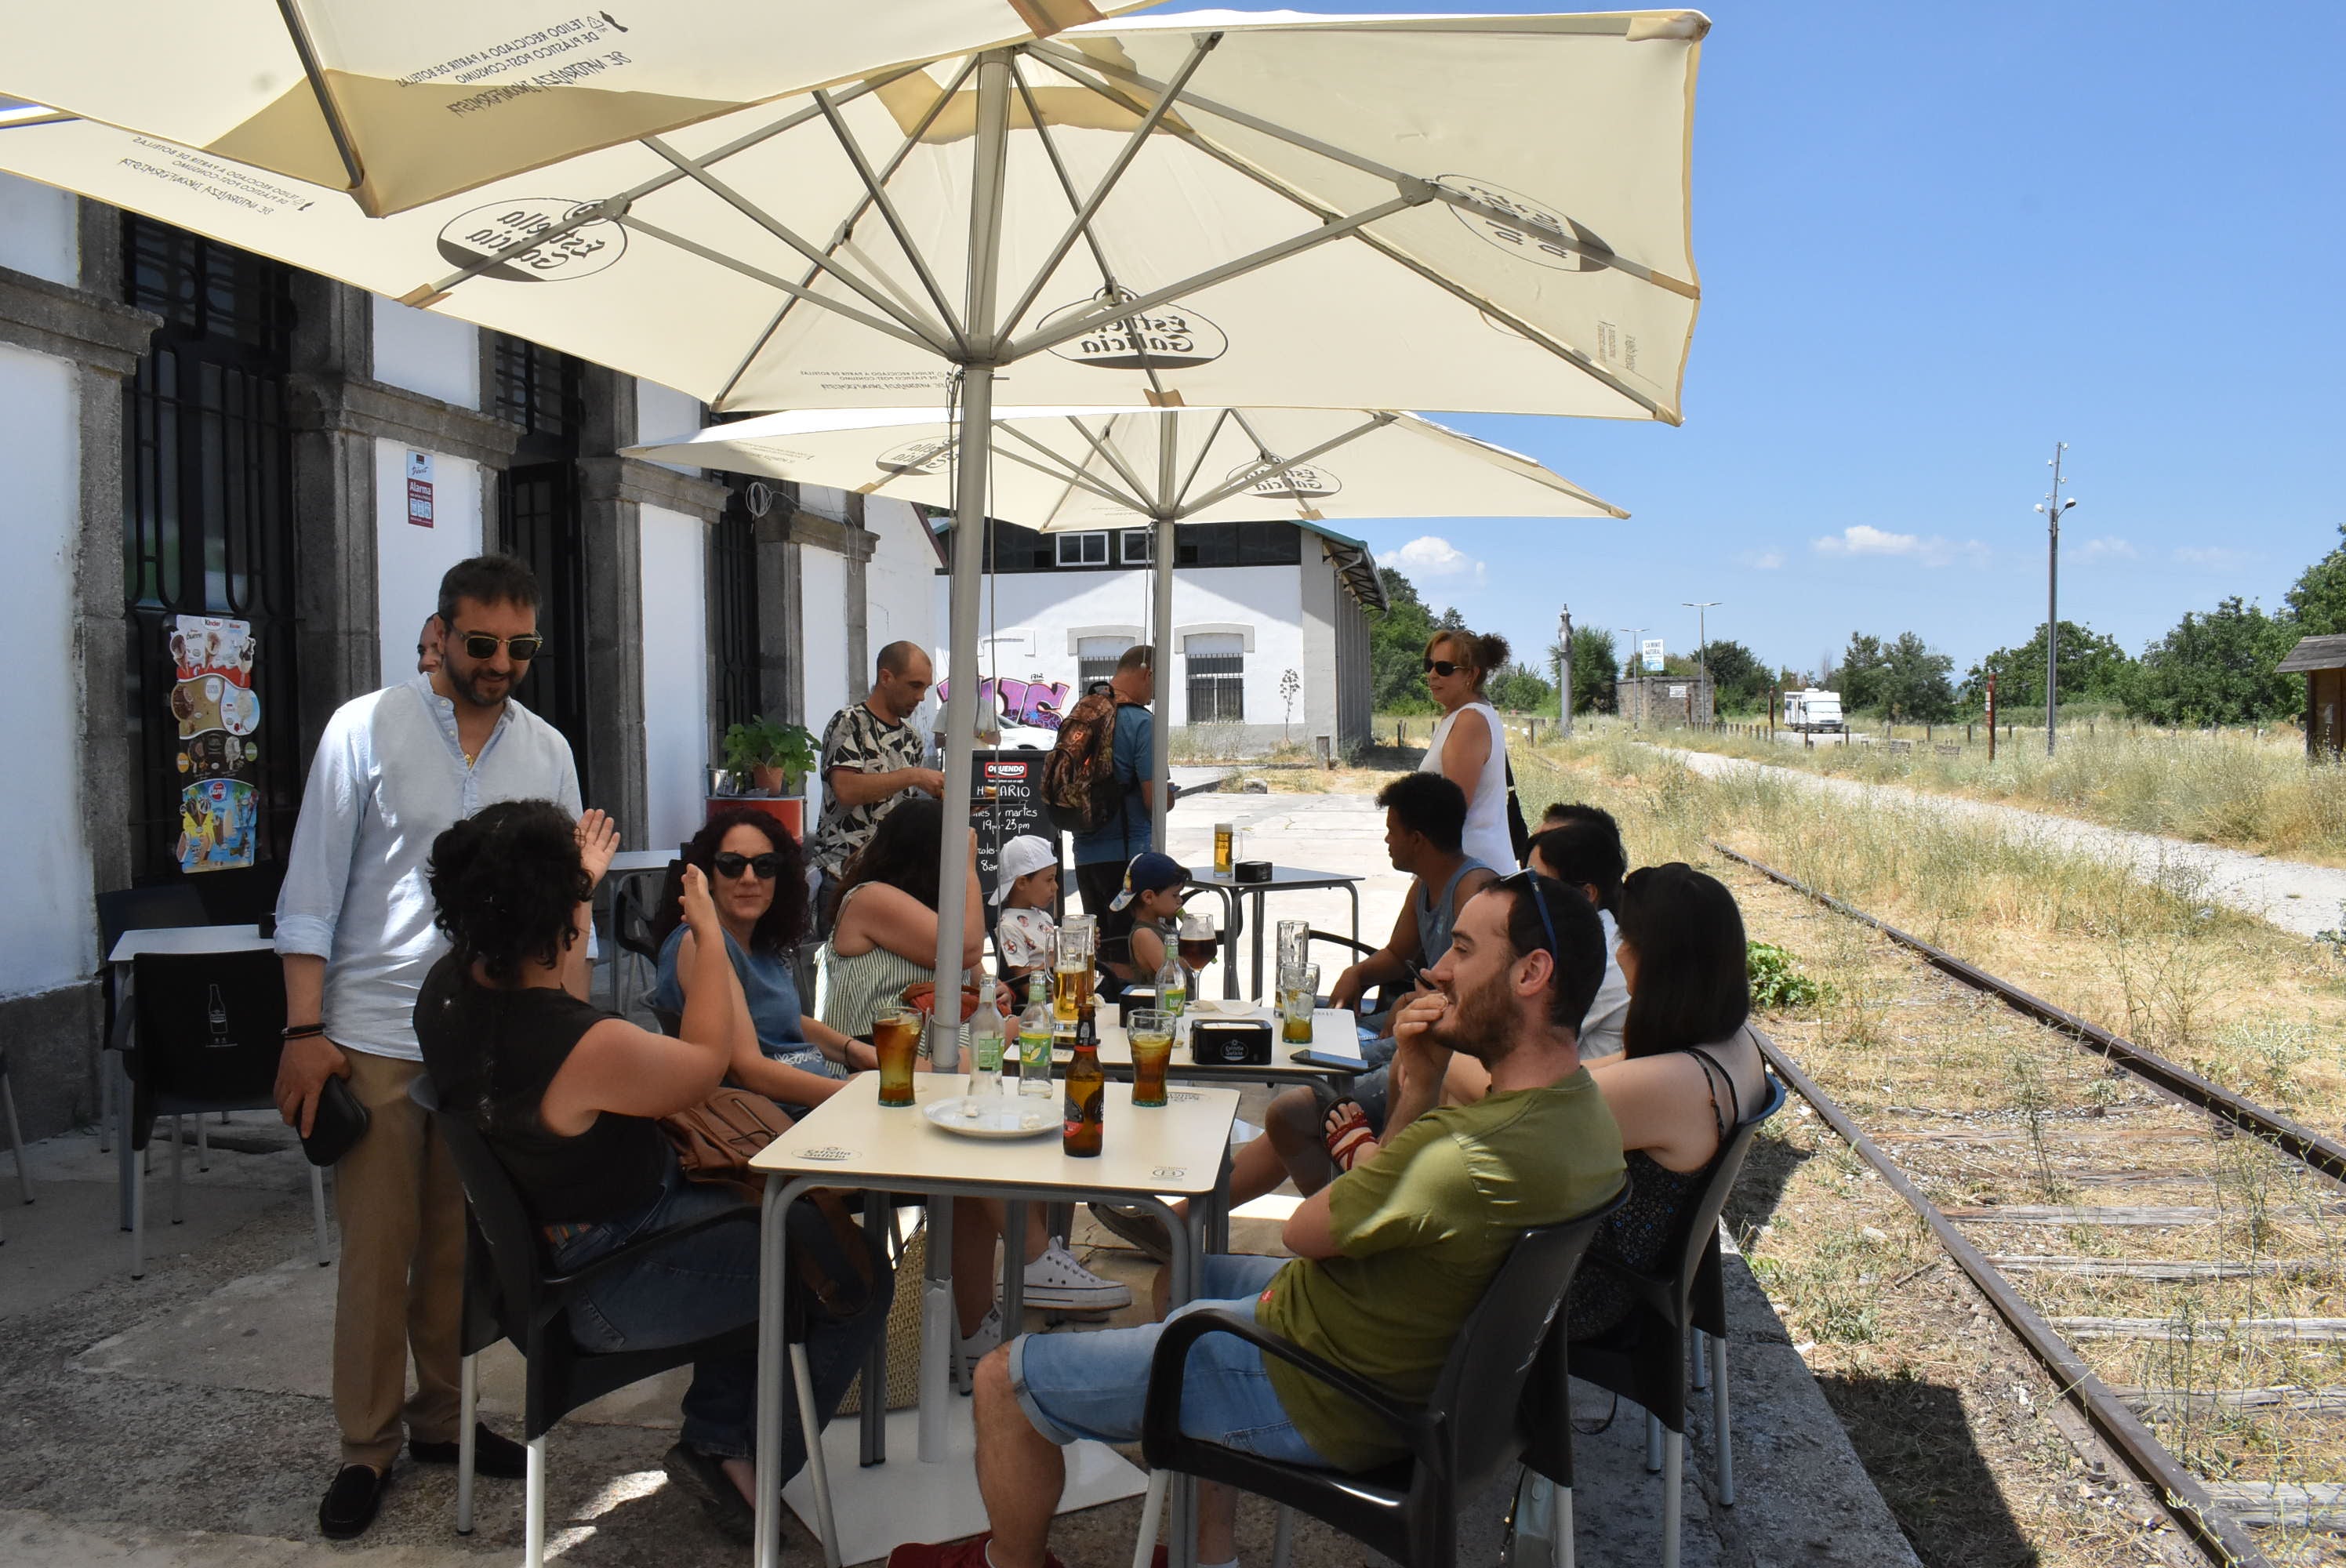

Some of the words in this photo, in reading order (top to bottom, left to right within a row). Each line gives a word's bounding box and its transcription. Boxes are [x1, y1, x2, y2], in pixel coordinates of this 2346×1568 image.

[409, 481, 431, 495] Alarma
[977, 785, 1030, 797] HARIO
[1005, 803, 1037, 817] martes
